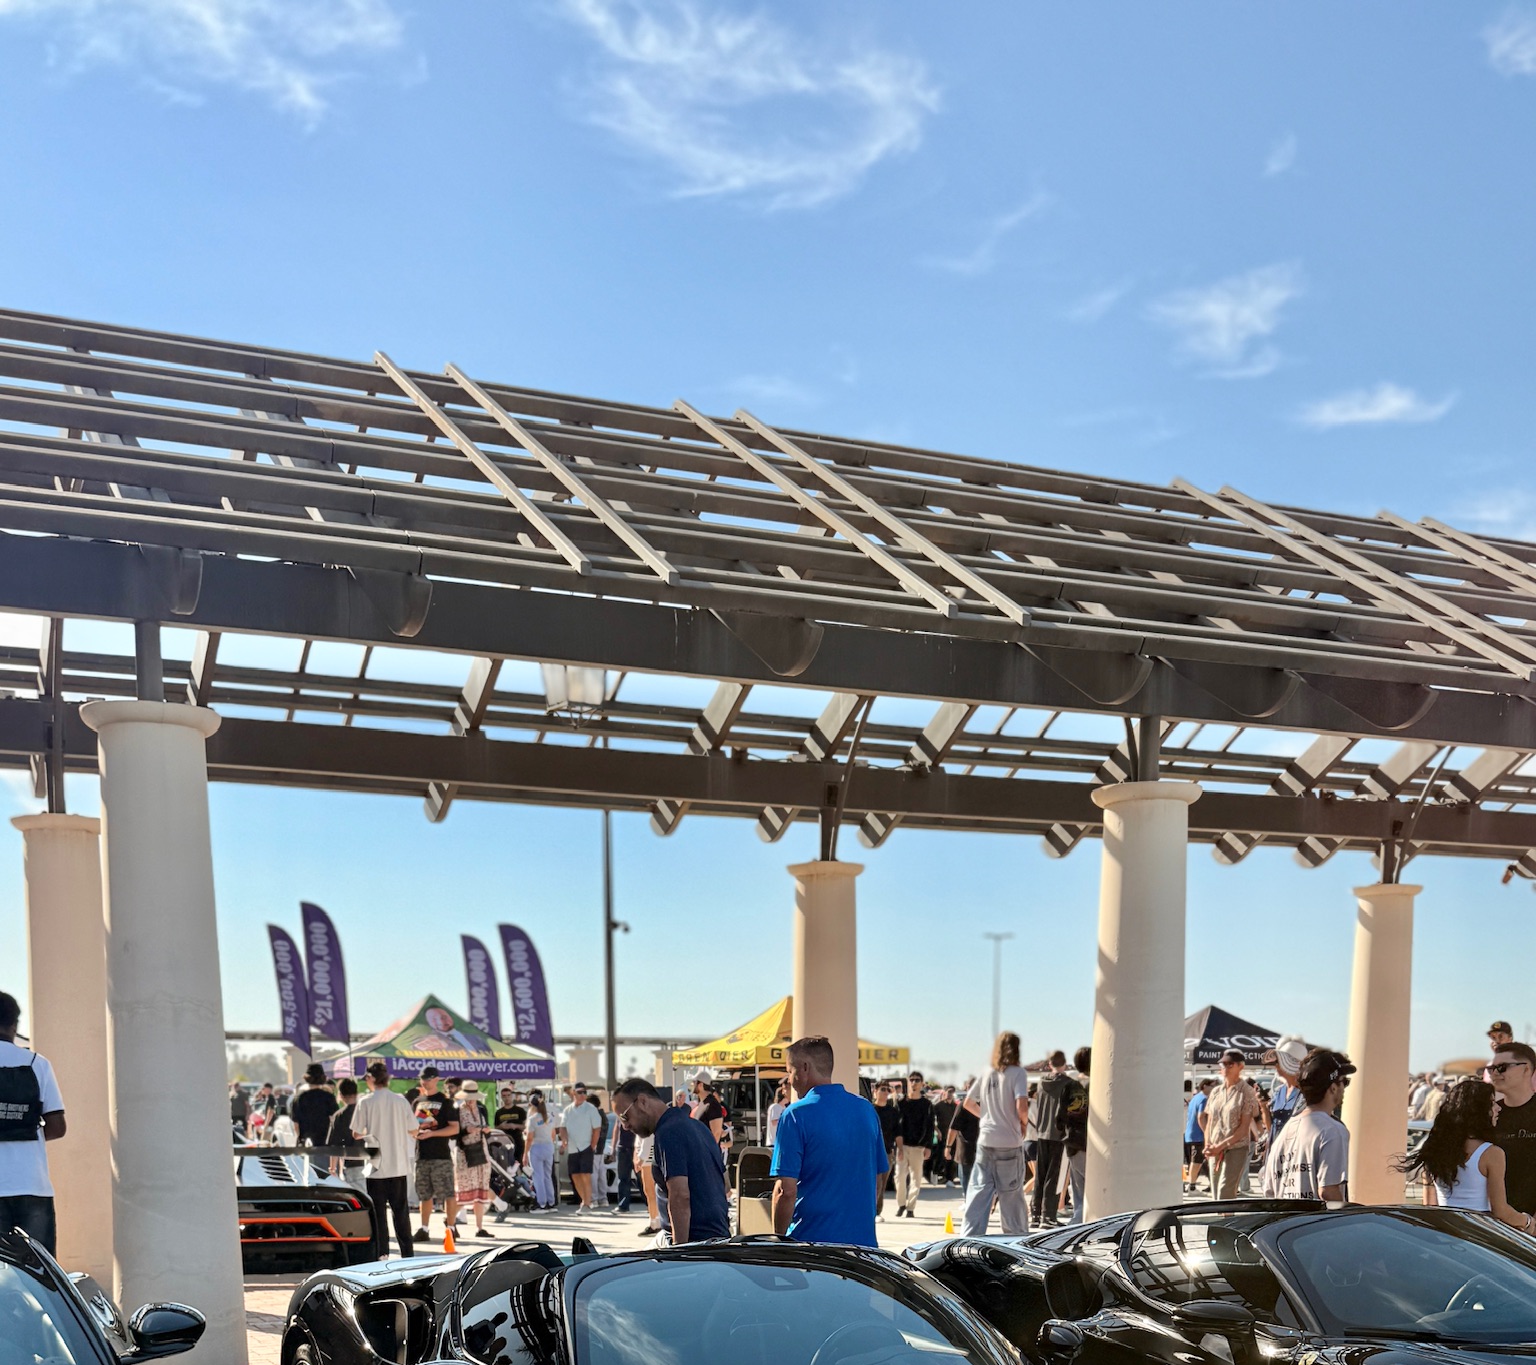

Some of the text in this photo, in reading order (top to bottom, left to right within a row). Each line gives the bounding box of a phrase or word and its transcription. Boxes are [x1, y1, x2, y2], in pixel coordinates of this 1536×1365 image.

[309, 921, 334, 1026] $21,000,000
[508, 939, 537, 1040] $12,600,000
[1199, 1051, 1221, 1059] PAINT
[1203, 1035, 1280, 1049] VOI
